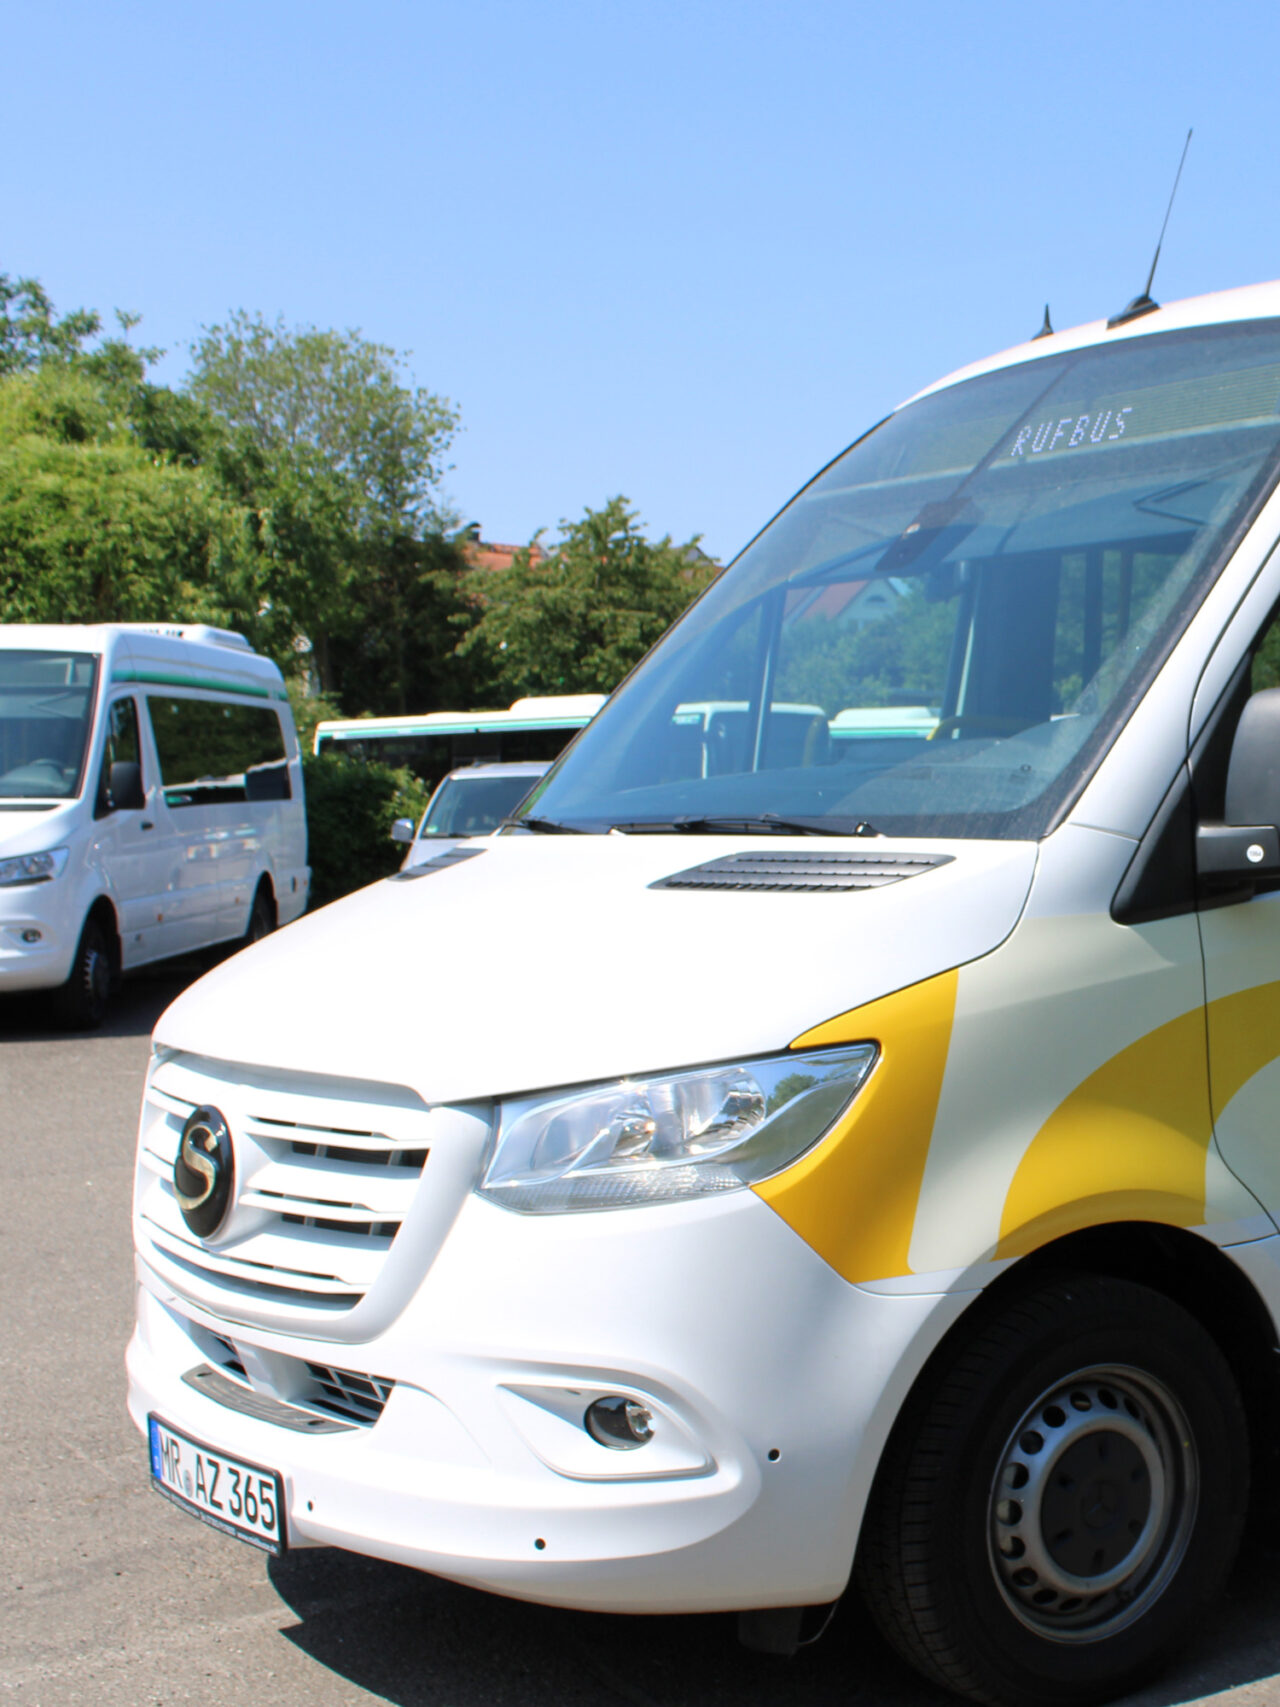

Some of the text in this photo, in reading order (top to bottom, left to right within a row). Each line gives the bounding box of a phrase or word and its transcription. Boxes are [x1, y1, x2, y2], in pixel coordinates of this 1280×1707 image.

[1010, 406, 1133, 457] RUFBUS
[159, 1430, 184, 1490] MR
[196, 1453, 225, 1511] AZ
[228, 1467, 276, 1532] 365
